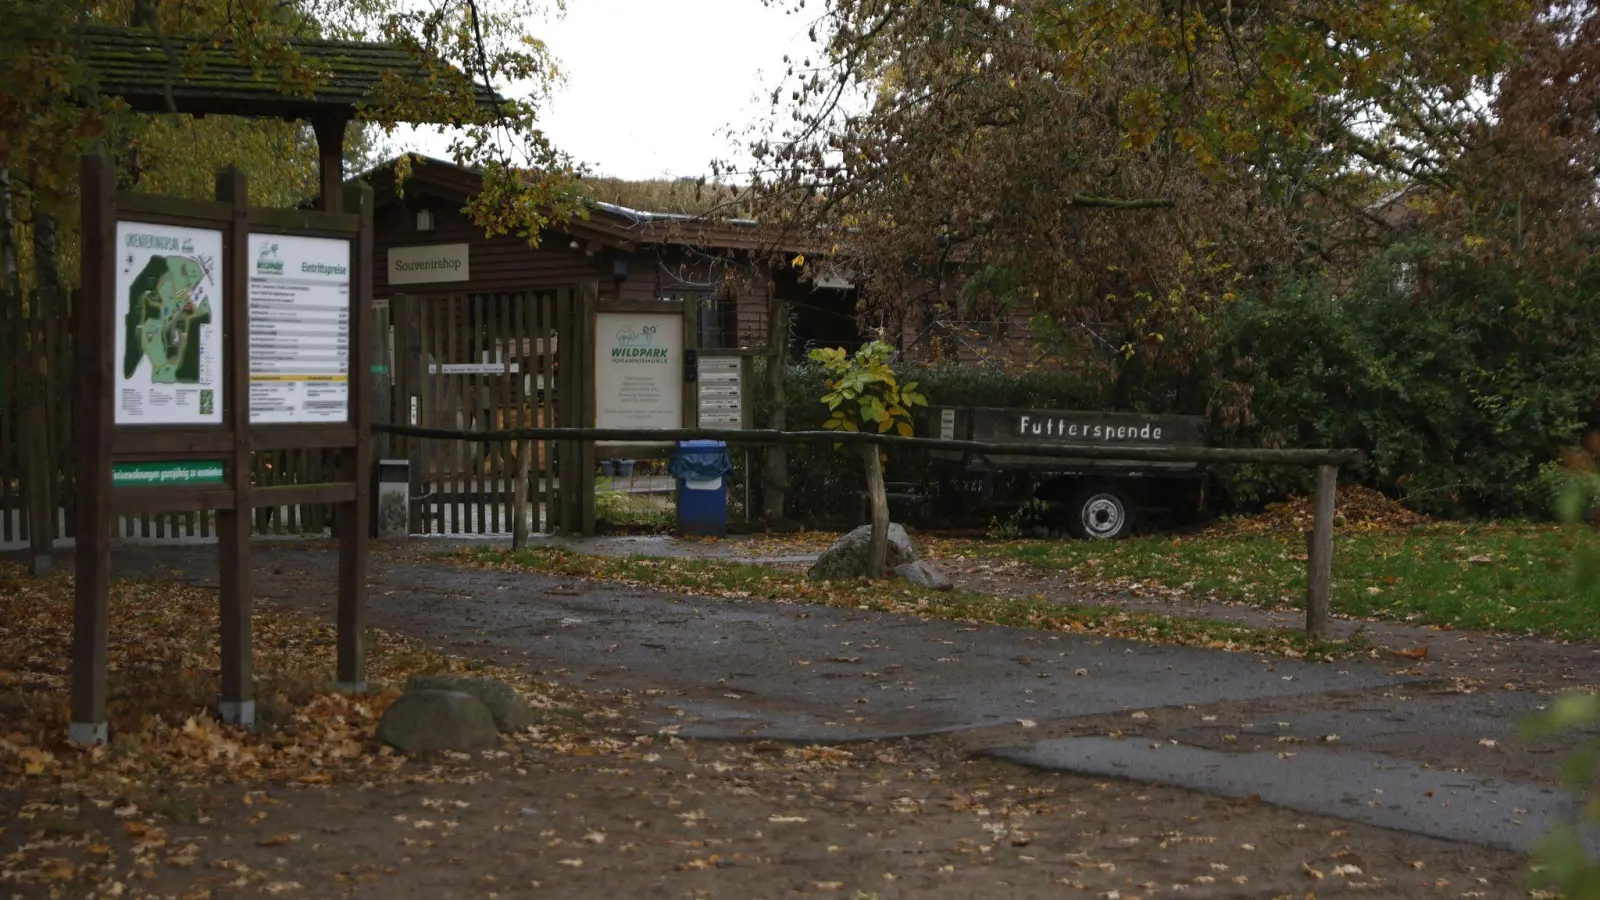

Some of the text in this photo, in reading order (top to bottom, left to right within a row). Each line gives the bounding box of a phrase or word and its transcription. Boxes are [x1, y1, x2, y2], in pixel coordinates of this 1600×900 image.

[301, 262, 347, 275] Eintrittspreise
[395, 257, 461, 271] Souvenirshop
[611, 348, 668, 357] WILDPARK
[1020, 416, 1162, 440] Futterspende
